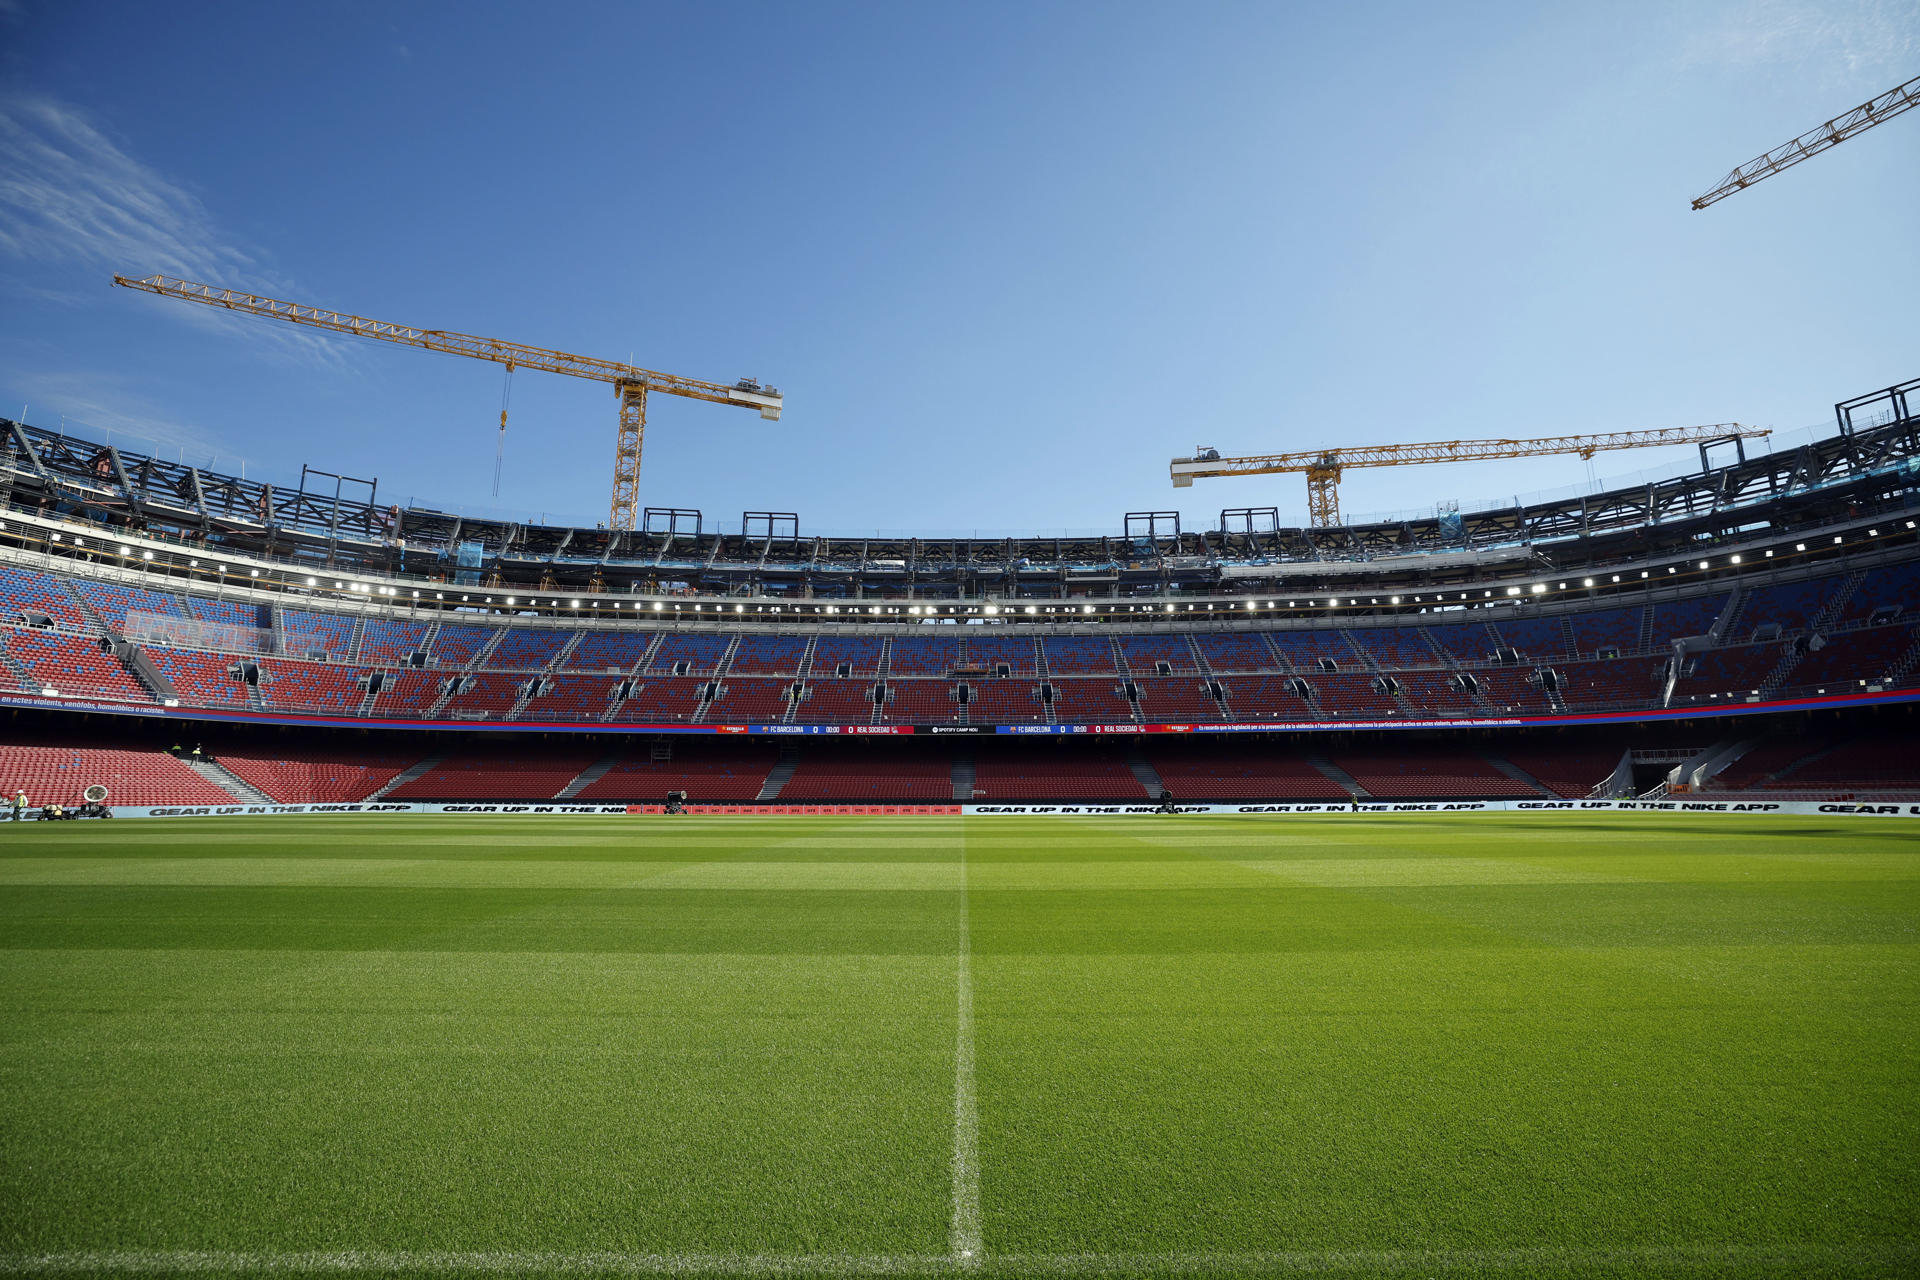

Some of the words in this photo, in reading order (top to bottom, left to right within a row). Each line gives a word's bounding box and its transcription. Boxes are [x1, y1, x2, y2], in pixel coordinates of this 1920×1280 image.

[34, 699, 62, 707] violents,
[64, 701, 96, 709] xenòfobs,
[98, 703, 134, 712] homofòbics
[149, 808, 210, 816] GEAR
[1818, 805, 1900, 814] GEAR
